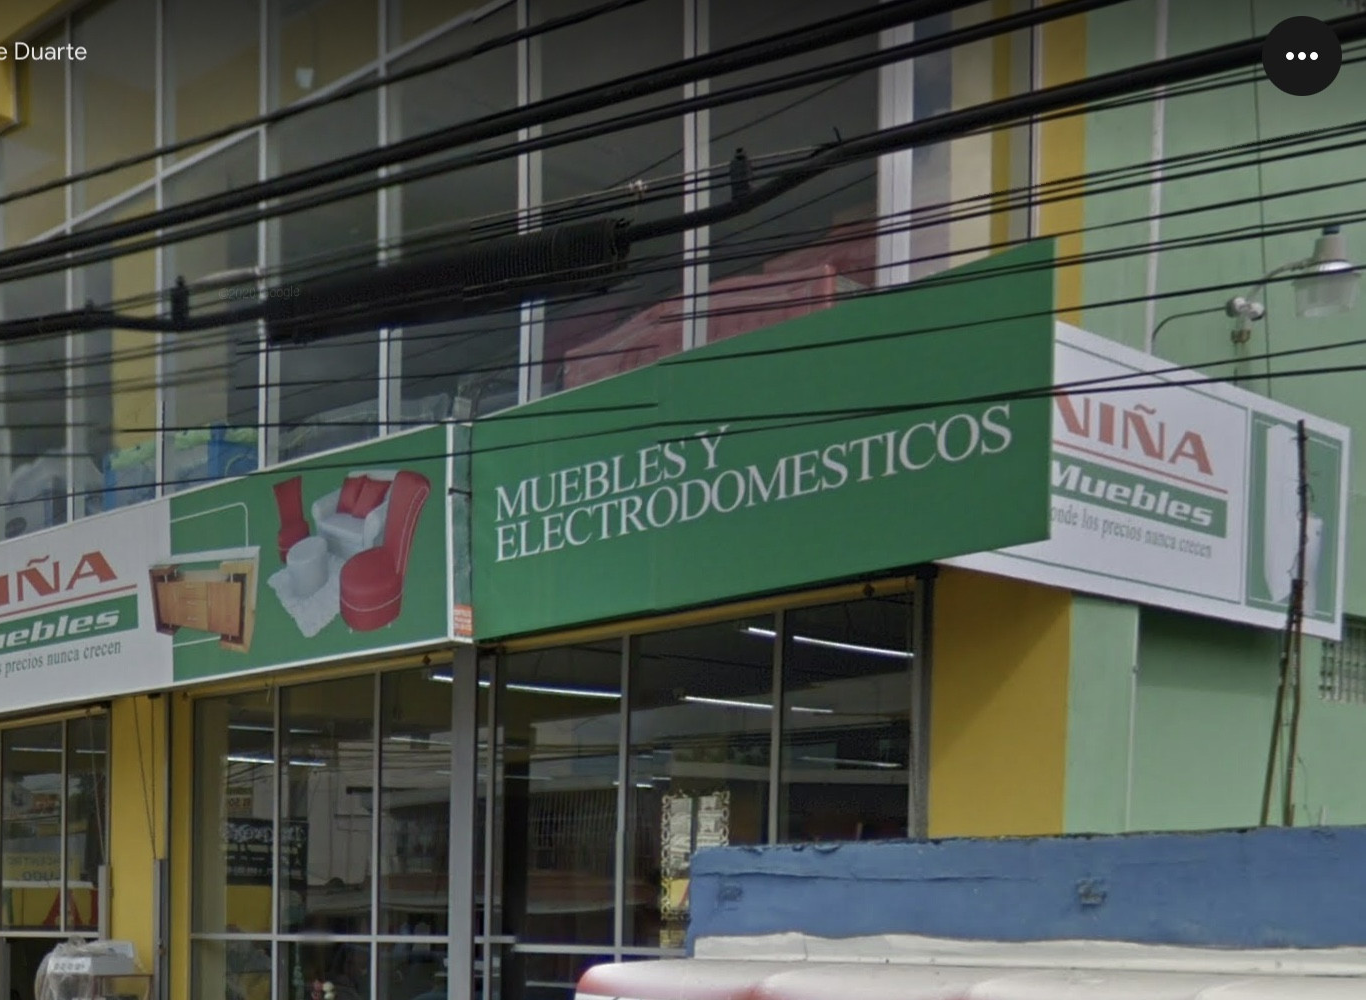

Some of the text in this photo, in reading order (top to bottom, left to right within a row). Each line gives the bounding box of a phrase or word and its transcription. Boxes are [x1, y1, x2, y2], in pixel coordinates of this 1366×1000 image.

[1053, 389, 1213, 476] NIÑA
[494, 424, 730, 522] MUEBLES Y
[494, 403, 1013, 562] ELECTRODOMESTICOS
[1051, 460, 1213, 526] Muebles
[1051, 504, 1213, 559] onde los precios nunca crecen
[5, 651, 43, 678] precios
[47, 647, 79, 666] nunca
[83, 641, 121, 659] crecen
